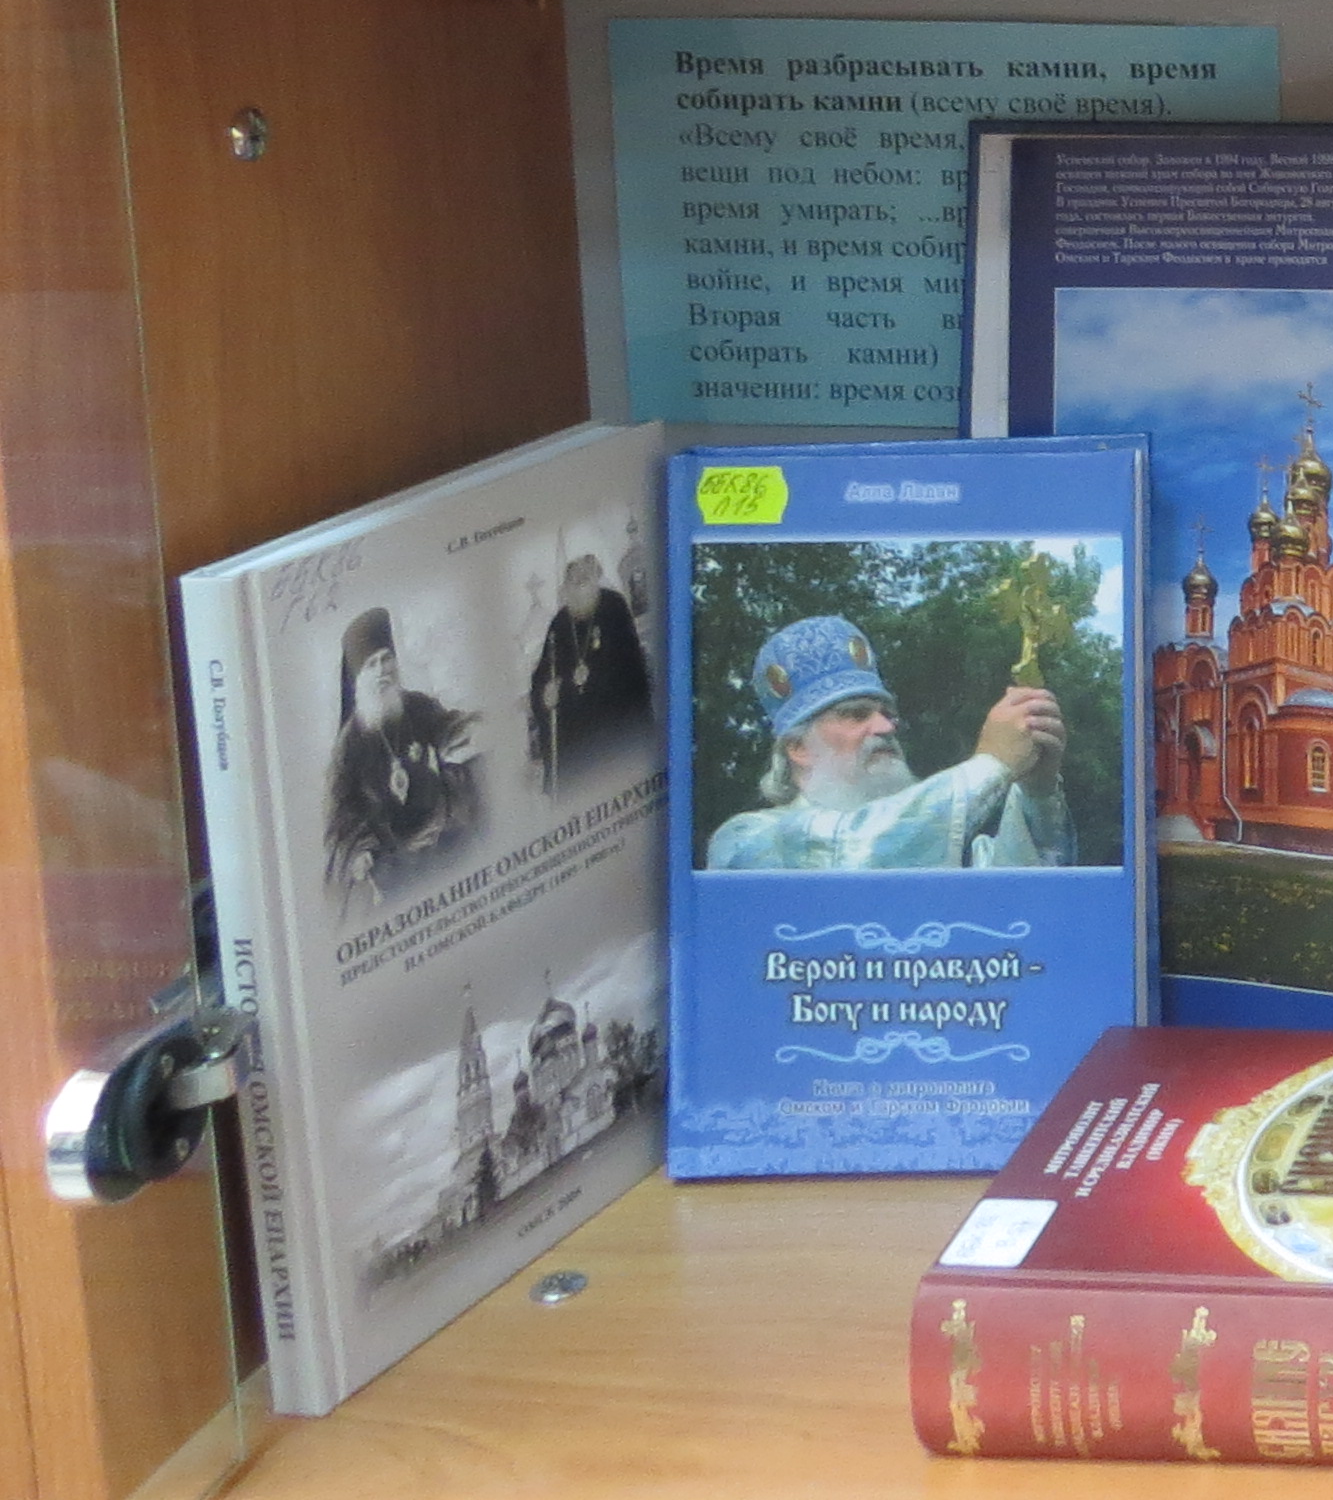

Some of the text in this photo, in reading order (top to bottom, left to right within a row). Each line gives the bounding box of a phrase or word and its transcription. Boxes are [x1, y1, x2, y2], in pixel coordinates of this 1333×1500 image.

[676, 51, 1218, 83] Время разбрасывать камни, время
[676, 90, 1172, 119] собирать камни (всему своё время).
[336, 868, 492, 965] ОБРАЗОВАНИЕ
[496, 815, 582, 877] ОМСКОЙ
[766, 951, 856, 986] Верой
[866, 957, 883, 978] и
[894, 953, 1020, 986] правдой
[792, 994, 1007, 1030] Богу и народу
[233, 937, 295, 1342] ИСТОЯ ОМСКОЙ ЕПАРХИИ
